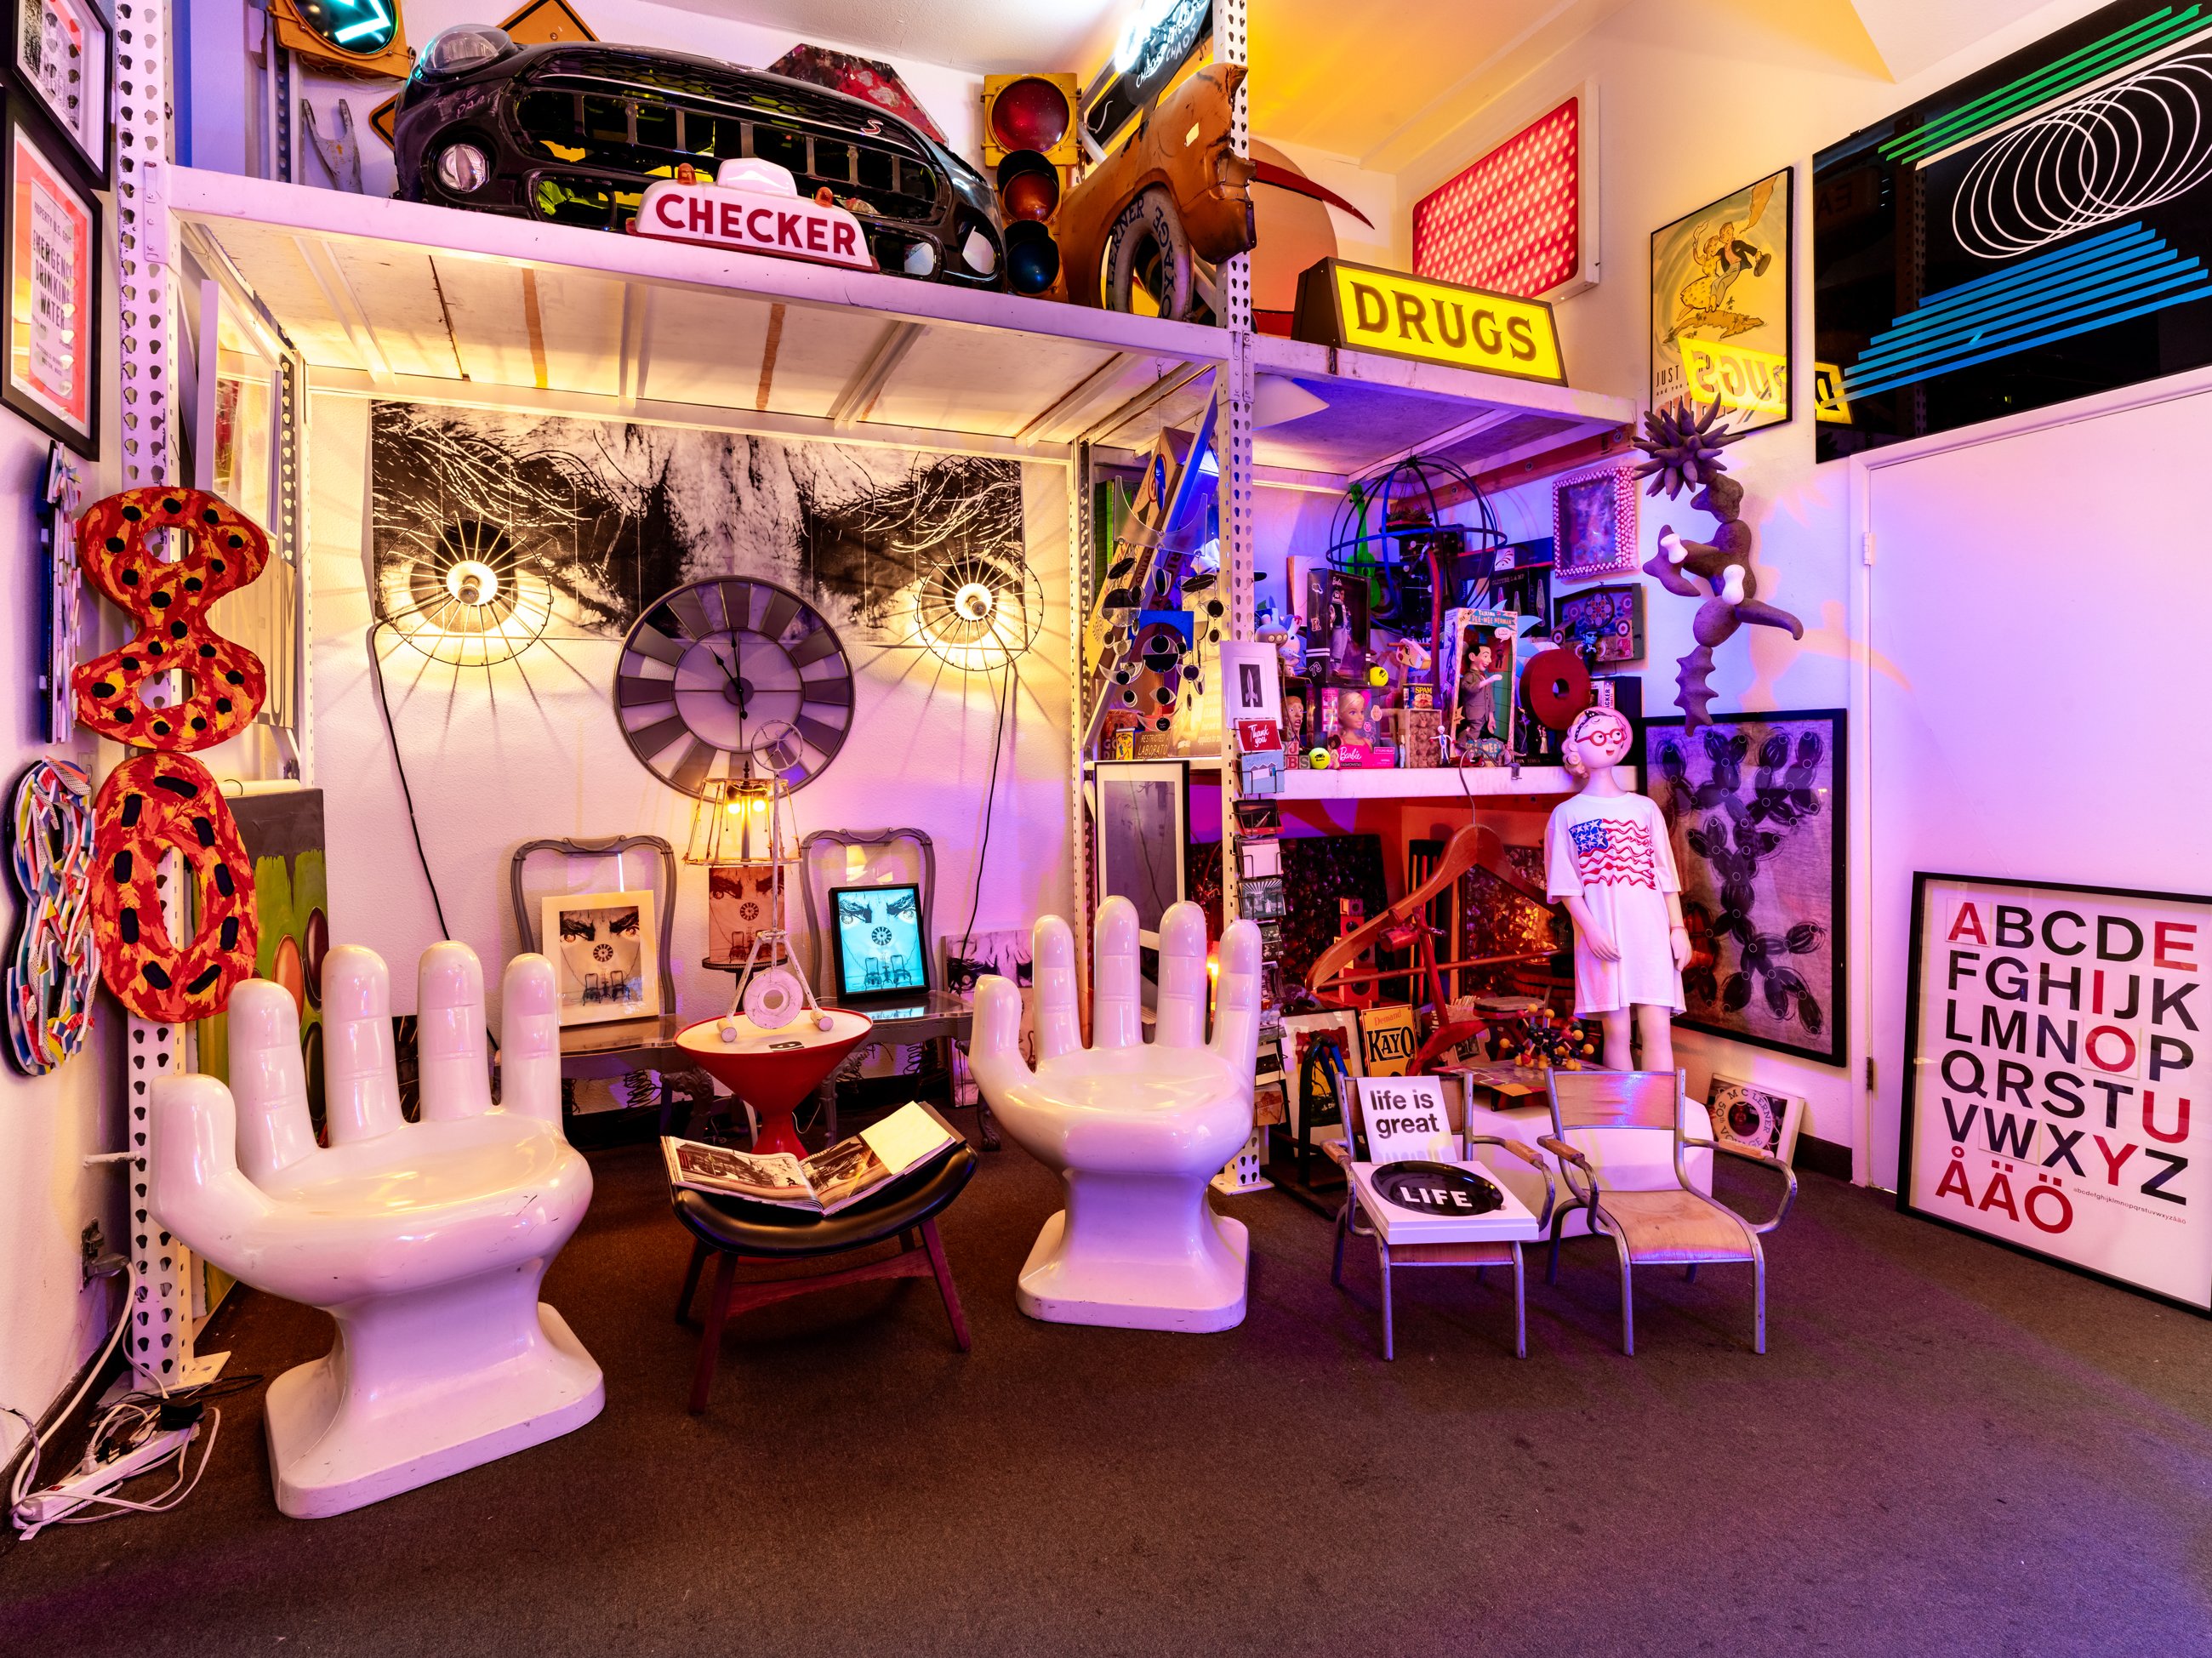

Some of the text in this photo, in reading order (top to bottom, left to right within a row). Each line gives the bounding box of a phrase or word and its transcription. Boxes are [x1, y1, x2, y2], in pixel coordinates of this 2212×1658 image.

[1166, 19, 1197, 62] CHAOS
[860, 119, 884, 134] S
[655, 193, 857, 257] CHECKER
[1107, 197, 1145, 288] LERNER
[33, 230, 72, 285] EMERGENCY
[1153, 207, 1176, 318] OYAGE
[40, 291, 65, 330] WATER
[1349, 280, 1536, 362] DRUGS
[1656, 365, 1679, 386] JUST
[1415, 686, 1433, 694] SPAM
[1141, 734, 1166, 743] RESTRICTED
[1248, 724, 1269, 739] Thank
[1254, 737, 1268, 748] you
[1138, 744, 1169, 755] LABORATO
[1340, 746, 1361, 761] Barbie
[1374, 1010, 1401, 1026] Demand
[1370, 1089, 1434, 1110] life is
[1752, 1092, 1771, 1134] LERNER
[1376, 1114, 1440, 1139] great
[1720, 1125, 1763, 1147] VOGE
[1400, 1185, 1473, 1208] LIFE
